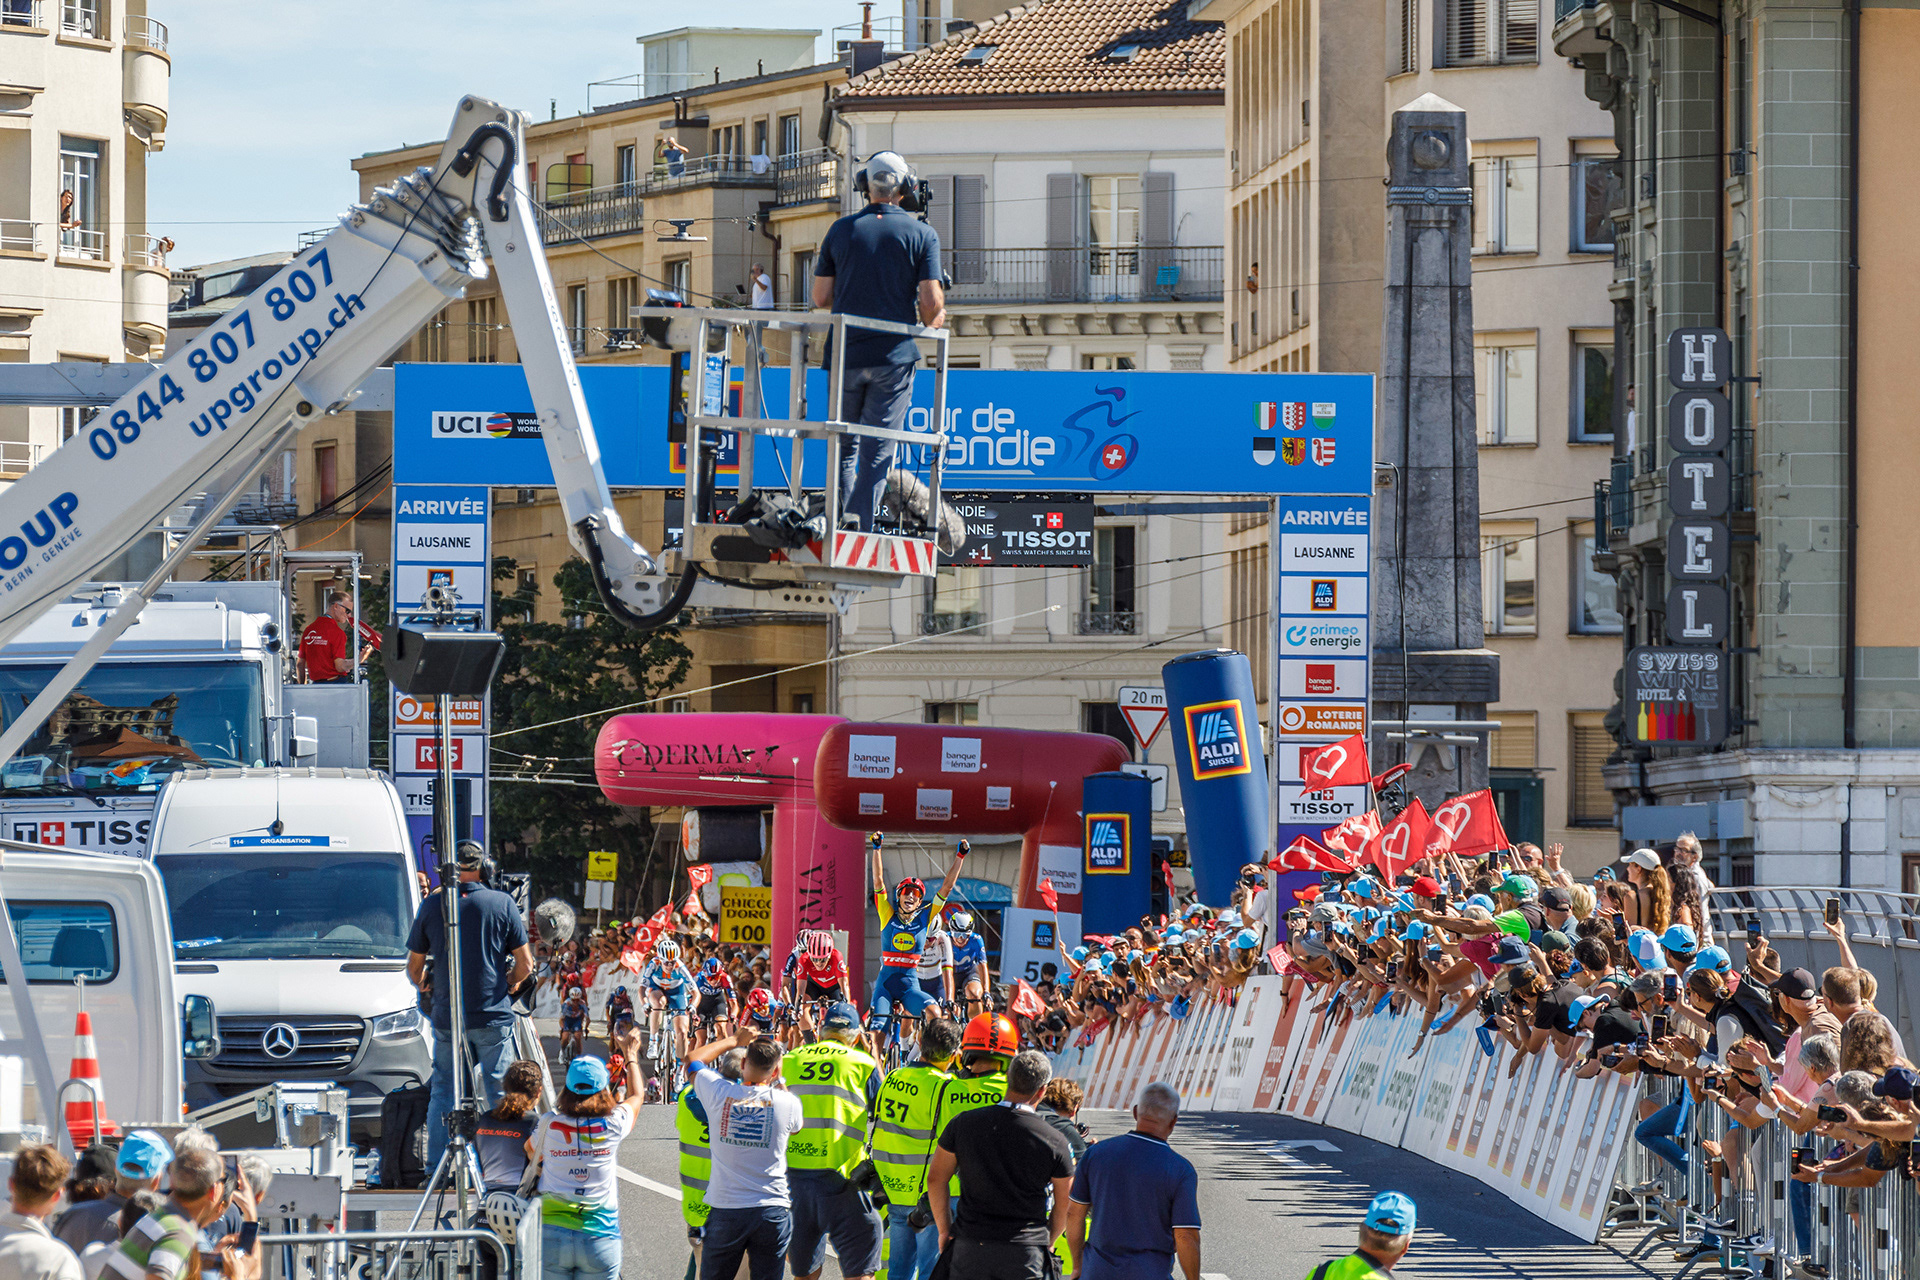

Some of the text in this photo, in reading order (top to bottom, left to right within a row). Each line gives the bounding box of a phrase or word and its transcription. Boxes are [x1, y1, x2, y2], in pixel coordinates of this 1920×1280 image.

[88, 247, 335, 461] 0844 807 807
[188, 289, 366, 437] upgroup.ch
[910, 401, 1015, 433] our de
[438, 416, 482, 433] UCI
[1682, 334, 1717, 637] HOTEL
[398, 496, 484, 515] ARRIVÉE
[1282, 507, 1368, 526] ARRIVÉE
[0, 491, 79, 581] OUP
[410, 536, 471, 548] LAUSANNE
[1002, 531, 1091, 548] TISSOT
[969, 543, 992, 560] +1
[1294, 547, 1355, 558] LAUSANNE
[4, 526, 82, 592] BERN GENÈVE
[1310, 624, 1358, 636] primeo
[1310, 635, 1361, 650] energie
[1637, 651, 1719, 671] SWISS
[1308, 677, 1332, 685] banque
[1637, 670, 1719, 690] WINE
[1131, 691, 1163, 704] 20 m
[1636, 688, 1673, 701] HOTEL
[1676, 688, 1687, 701] &
[440, 701, 479, 710] TERIE
[423, 711, 479, 720] ROANDE
[1317, 711, 1362, 720] LOTERIE
[1306, 721, 1362, 730] ROMANDE
[617, 743, 746, 766] C-DERMA
[946, 752, 976, 760] banque
[1200, 742, 1240, 760] ALDI
[854, 753, 890, 763] banque
[950, 760, 976, 768] léman
[1208, 756, 1235, 767] SUISSE
[859, 764, 890, 774] léman
[1290, 803, 1354, 814] TISSOT
[1091, 847, 1122, 859] ALDI
[1041, 867, 1077, 879] banque
[726, 910, 770, 920] D'ORO
[730, 925, 765, 941] 100
[883, 956, 919, 965] TREK
[799, 1046, 847, 1055] PHOTO
[799, 1061, 835, 1081] 39
[885, 1075, 918, 1096] PHOTO
[951, 1092, 1003, 1104] PHOTO
[885, 1098, 909, 1123] 37
[720, 1136, 770, 1149] CHAMONIX
[550, 1148, 611, 1158] TotalEnergies
